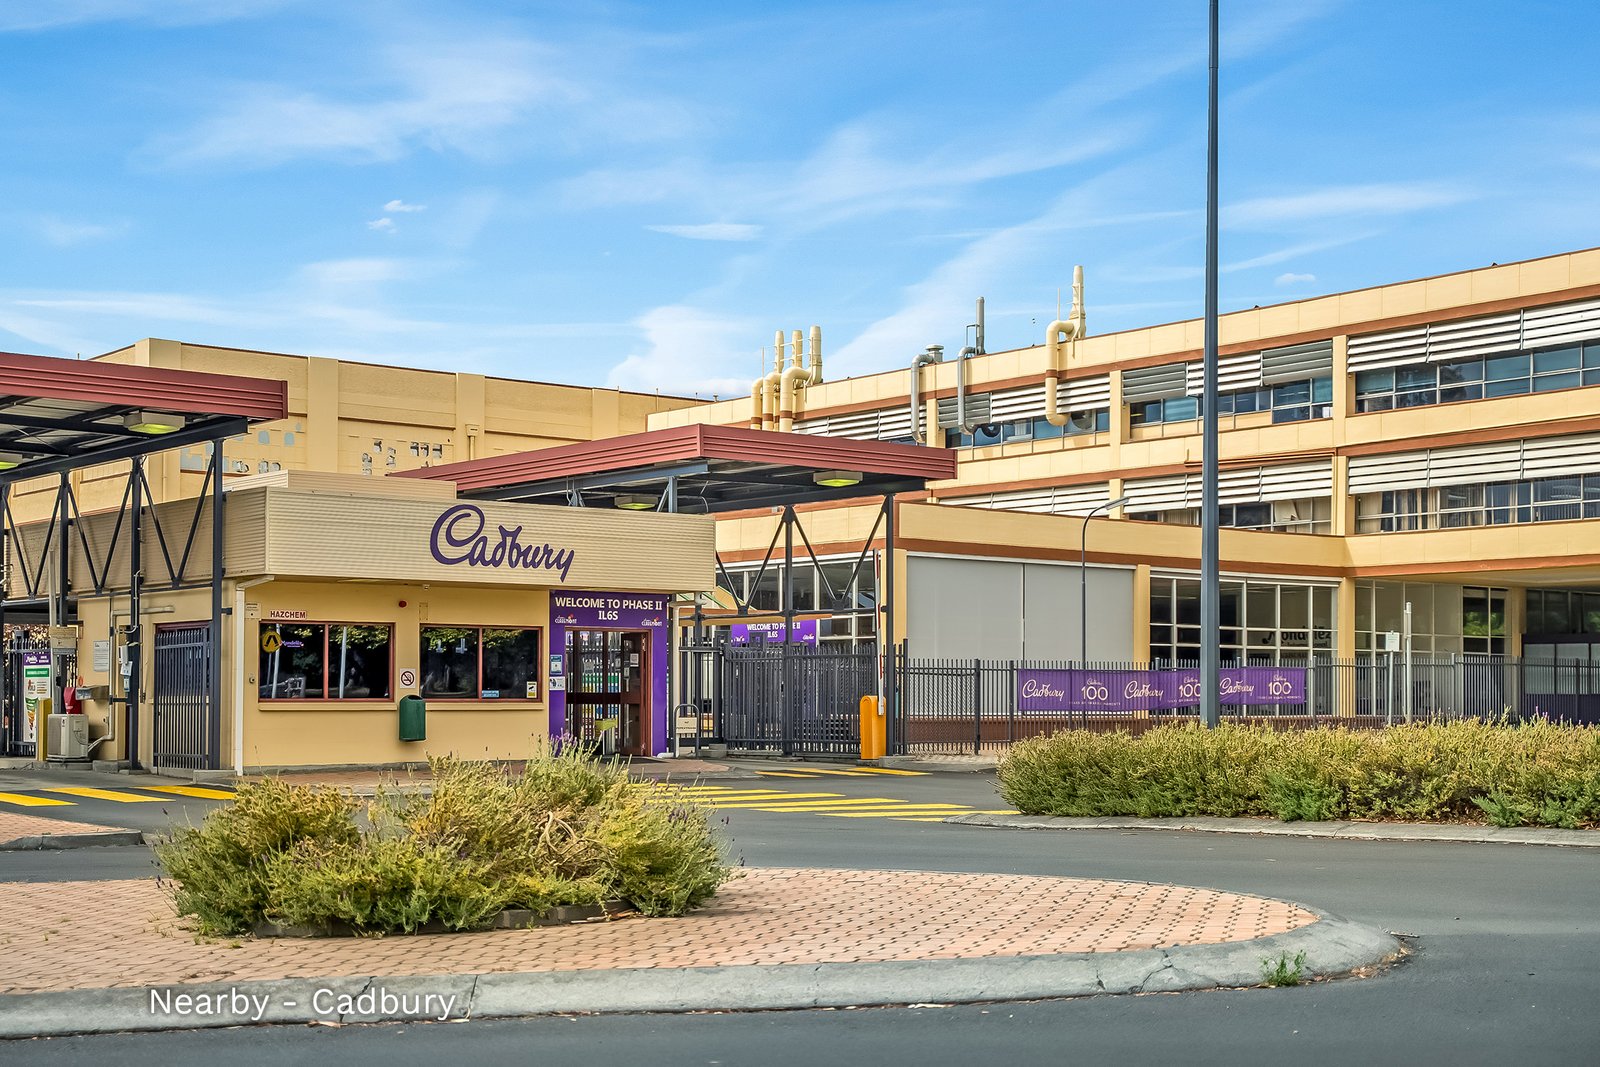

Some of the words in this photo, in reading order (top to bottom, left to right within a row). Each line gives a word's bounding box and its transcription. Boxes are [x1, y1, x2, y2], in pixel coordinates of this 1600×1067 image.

[430, 504, 575, 583] Cadbury
[555, 597, 605, 608] WELCOME
[607, 599, 620, 609] TO
[622, 600, 653, 610] PHASE
[655, 601, 662, 610] II
[270, 610, 306, 618] HAZCHEM
[598, 610, 619, 620] IL6S
[747, 623, 771, 631] WELCOME
[1022, 679, 1064, 701] Cadbury
[1081, 686, 1108, 700] 100
[1124, 680, 1164, 701] Cadbury
[1219, 677, 1254, 697] Cadbury
[1268, 681, 1292, 695] 100
